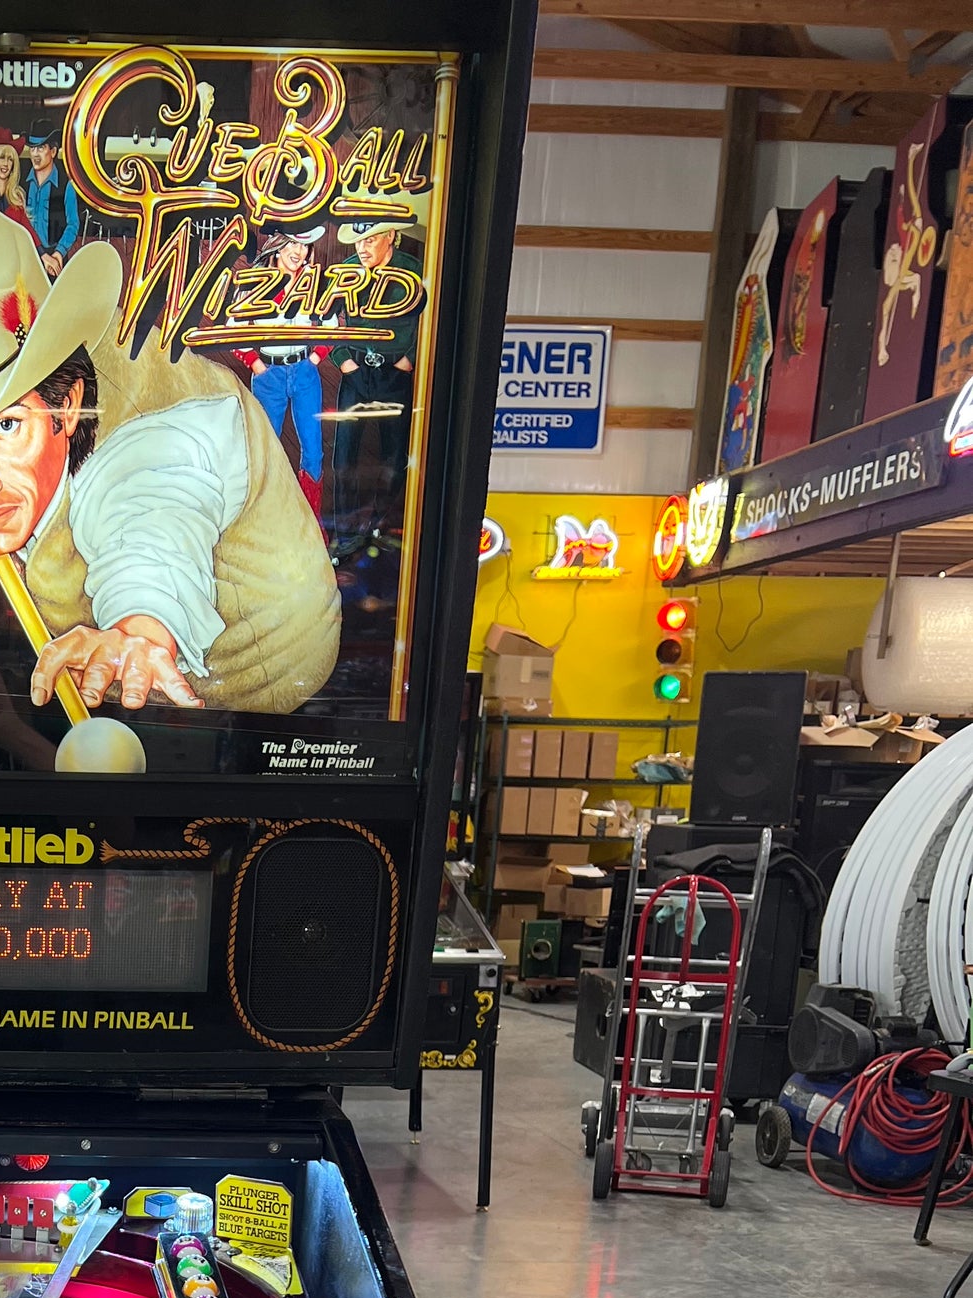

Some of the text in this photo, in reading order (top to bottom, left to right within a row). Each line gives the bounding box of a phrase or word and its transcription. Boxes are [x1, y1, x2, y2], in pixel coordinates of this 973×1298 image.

[504, 381, 591, 398] CENTER
[502, 413, 573, 428] CERTIFIED
[746, 450, 922, 526] SHOCKS-MUFFLERS
[262, 739, 357, 754] The Premier
[269, 756, 375, 769] Name in Pinball
[43, 881, 93, 909] AT
[60, 1011, 88, 1029] IN
[94, 1011, 194, 1030] PINBALL
[229, 1186, 279, 1201] PLUNGER
[220, 1194, 288, 1215] SKILL SHOT
[219, 1213, 244, 1223] SHOOT
[245, 1217, 277, 1229] 8-BALL
[219, 1222, 287, 1242] BLUE TARGETS
